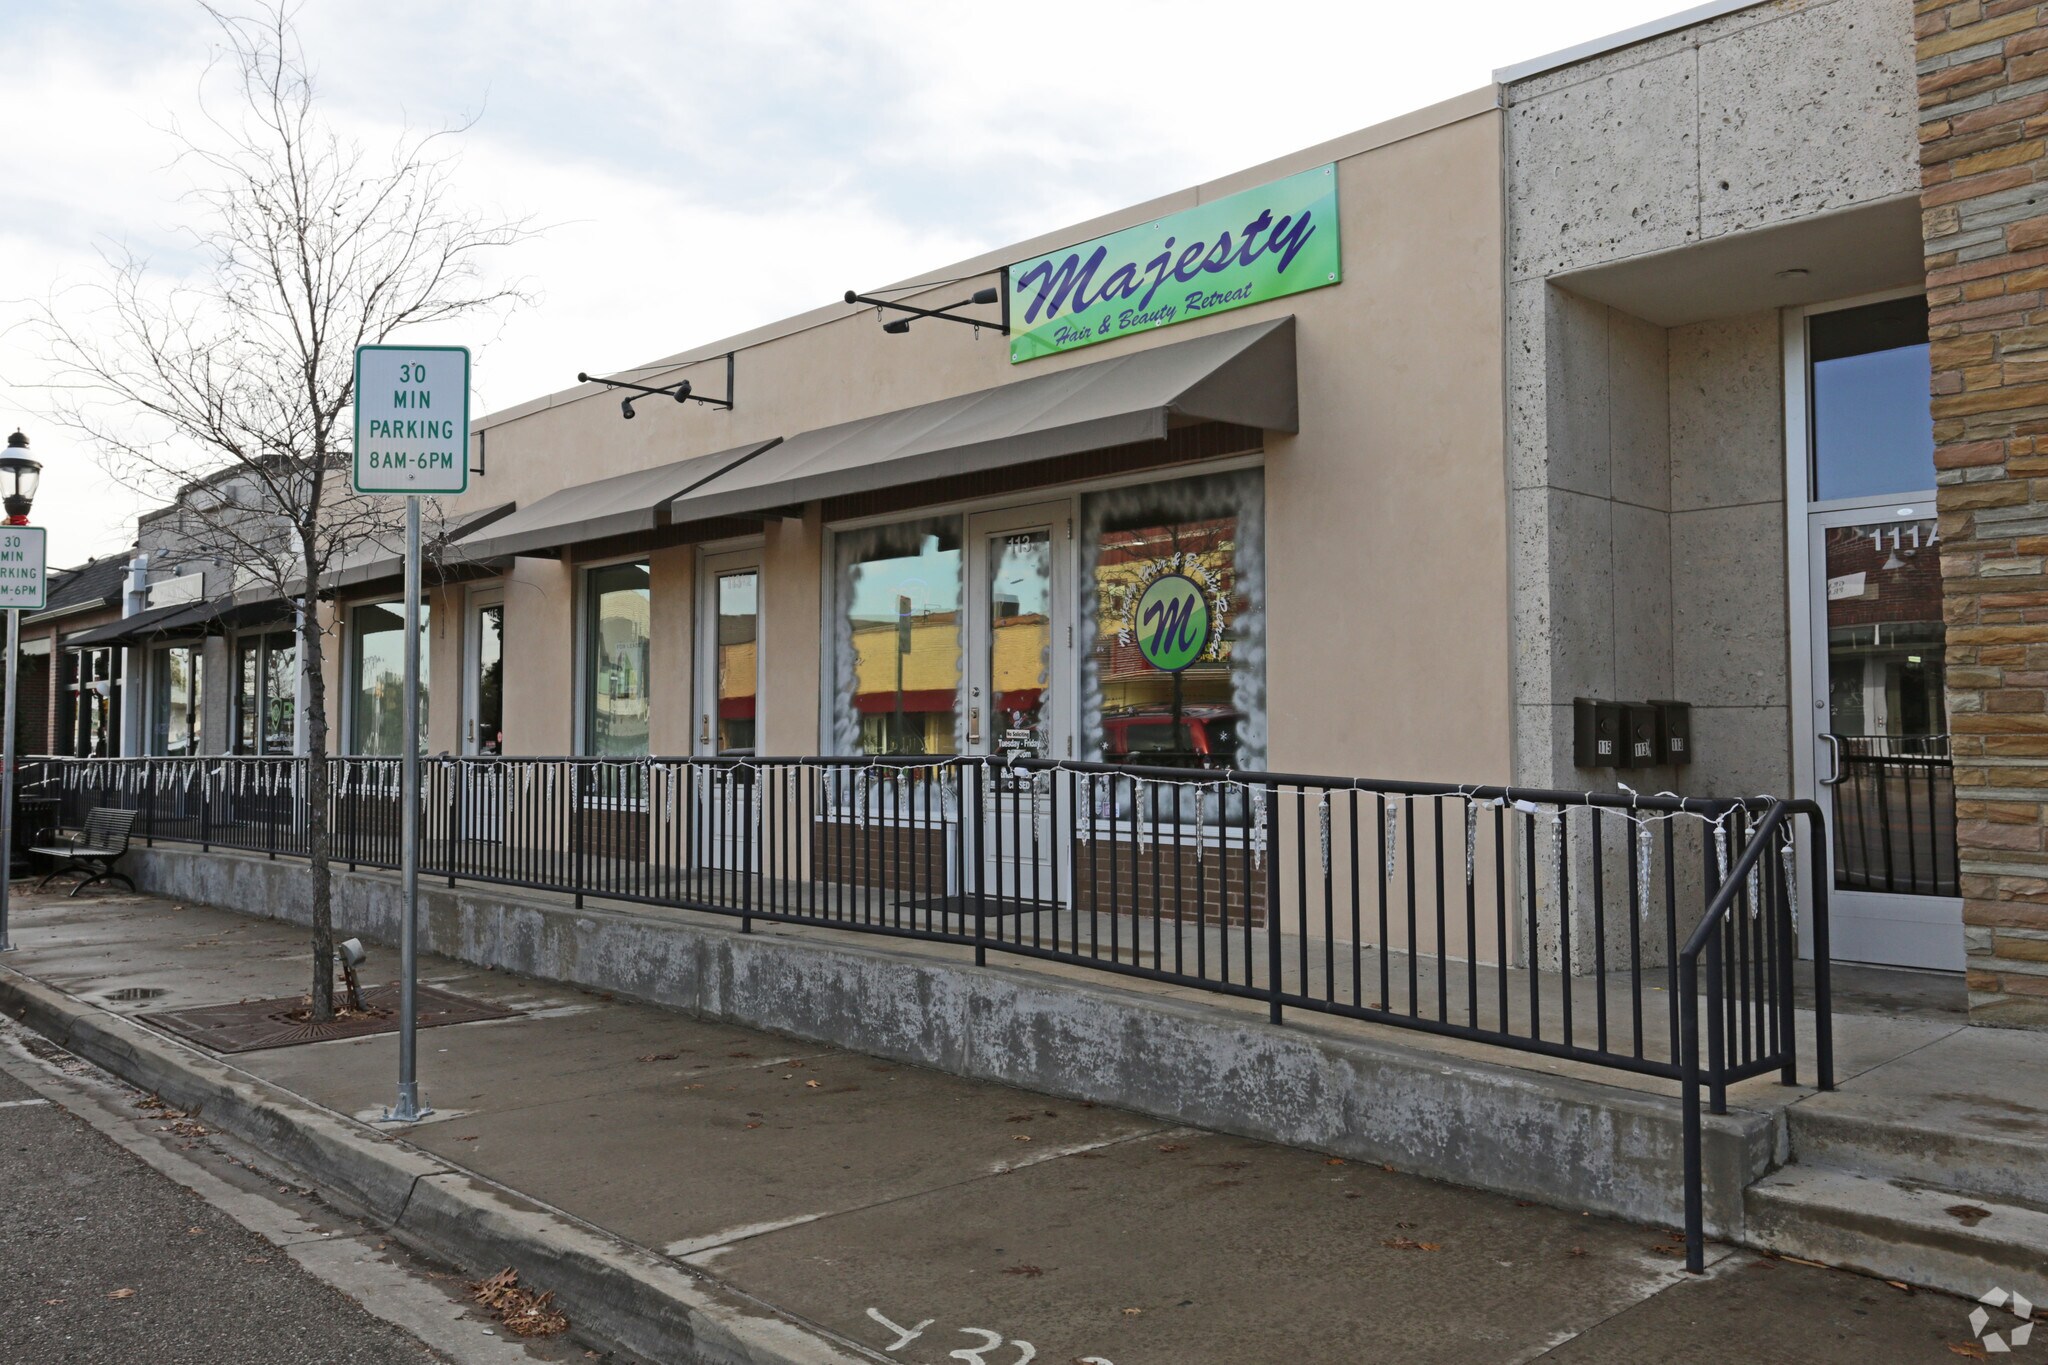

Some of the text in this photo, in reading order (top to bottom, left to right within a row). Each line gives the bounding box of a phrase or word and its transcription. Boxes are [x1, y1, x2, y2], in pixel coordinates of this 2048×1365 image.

[1017, 208, 1317, 325] Majesty
[1053, 282, 1253, 347] Hair & Beauty Retreat
[400, 364, 426, 383] 30
[394, 390, 430, 409] MIN
[370, 420, 453, 439] PARKING
[369, 451, 453, 469] 8AM-6PM
[4, 536, 21, 548] 30
[1008, 535, 1032, 554] 113
[1, 551, 24, 562] MIN
[1143, 593, 1198, 657] M
[998, 739, 1021, 749] Tuesday
[1024, 739, 1040, 749] Friday
[1599, 741, 1611, 754] 115
